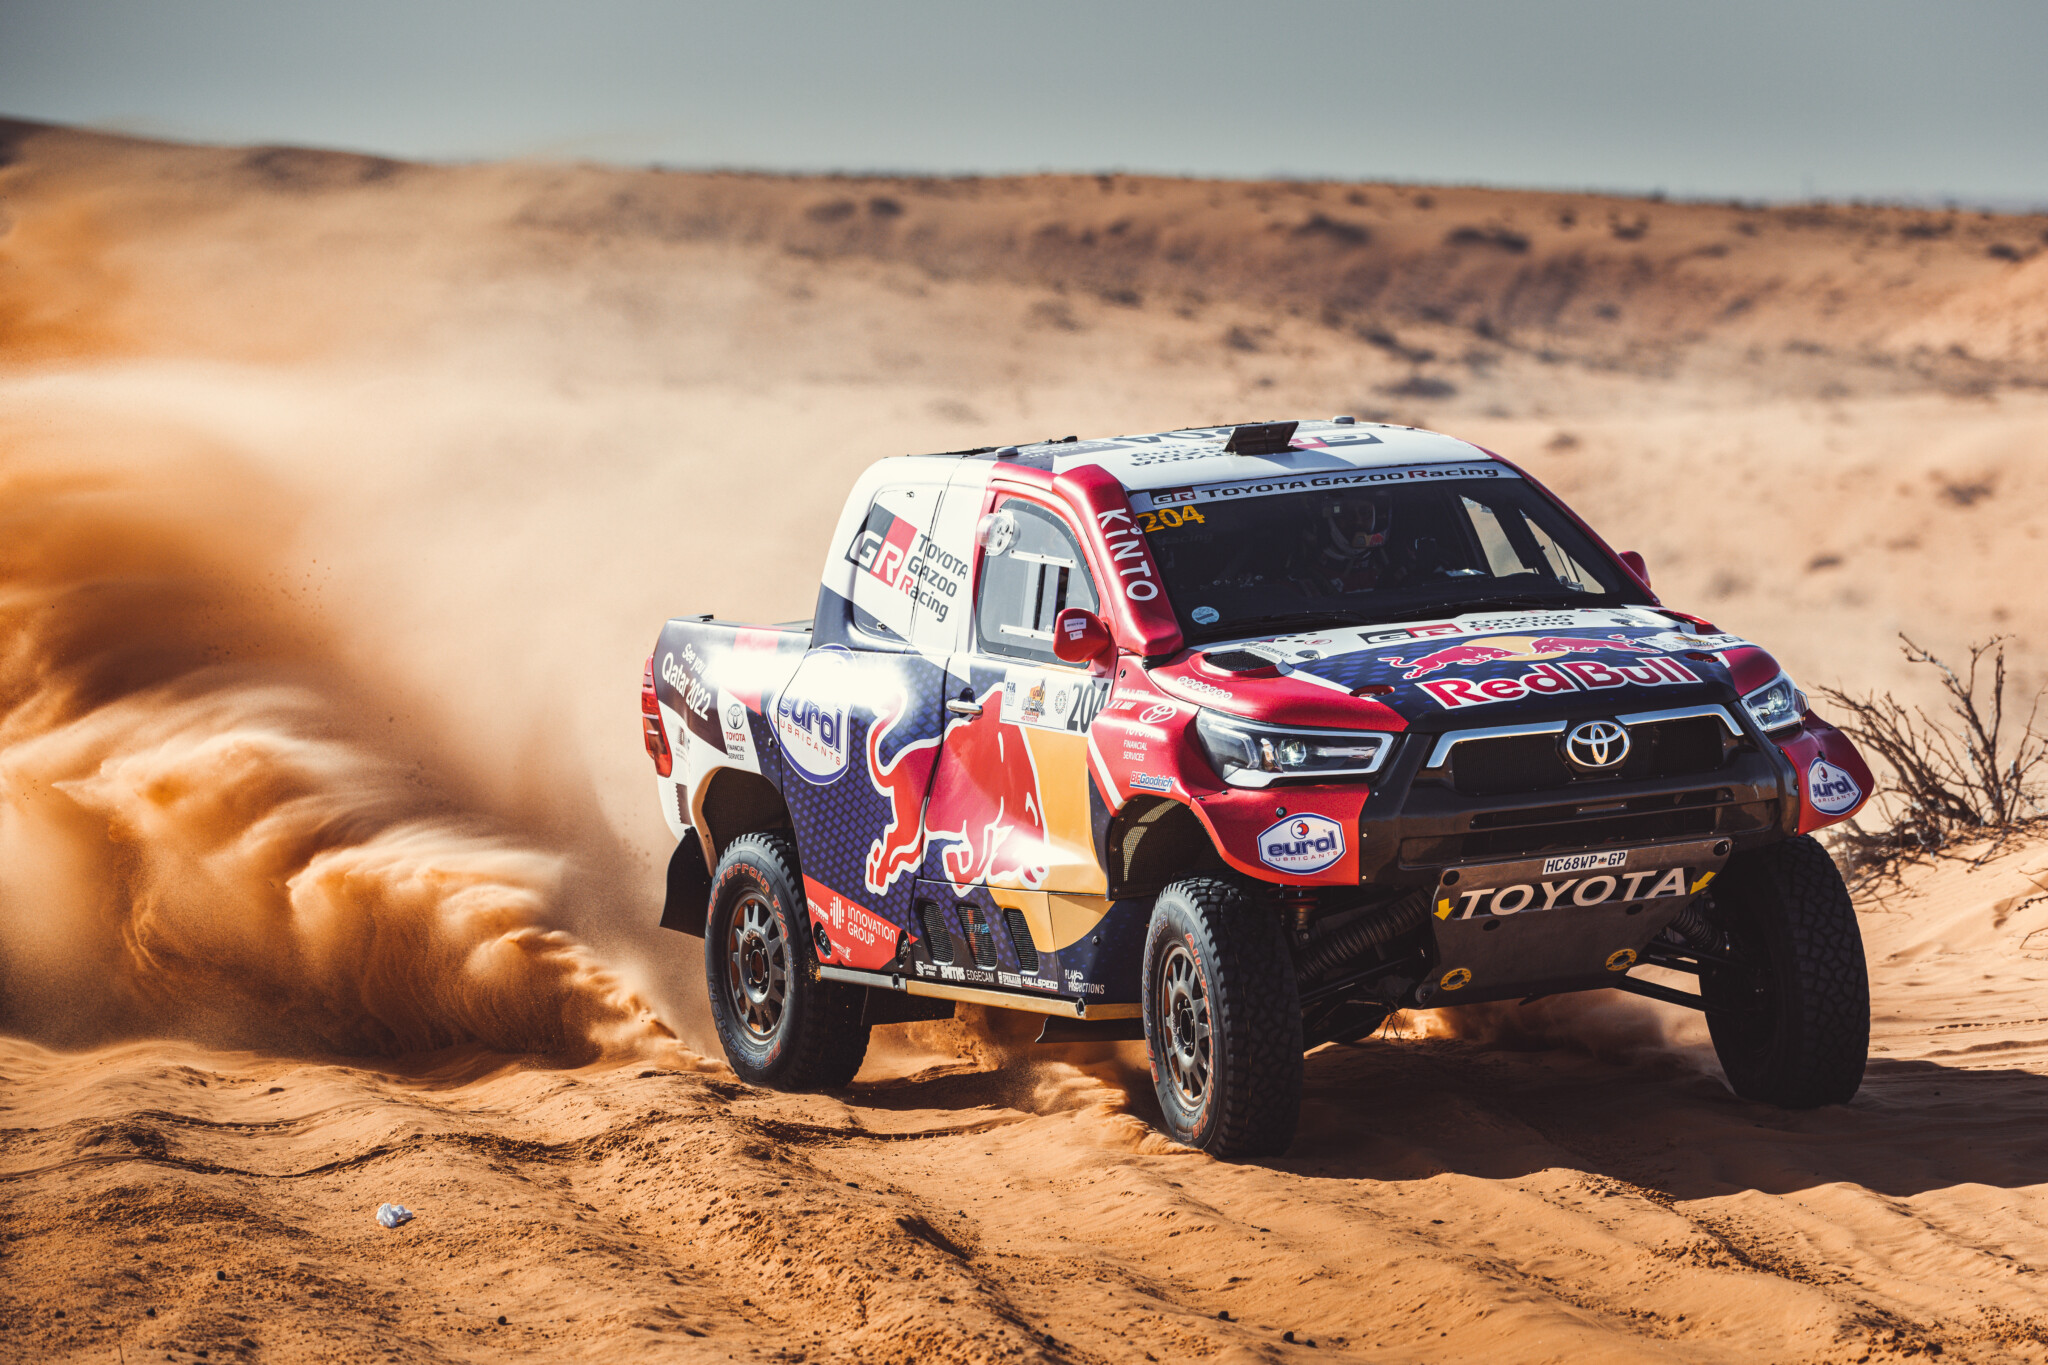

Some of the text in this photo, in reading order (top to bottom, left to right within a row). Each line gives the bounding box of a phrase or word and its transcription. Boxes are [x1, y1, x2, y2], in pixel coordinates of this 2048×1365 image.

[1153, 467, 1499, 505] GR TOYOTA GAZOO Racing
[1136, 505, 1205, 532] 204
[848, 529, 905, 585] GR
[918, 533, 968, 580] TOYOTA
[907, 556, 957, 598] GAZOO
[898, 574, 949, 623] Racing
[682, 643, 696, 666] See
[662, 652, 690, 699] Qatar
[685, 677, 712, 721] 2022
[1417, 657, 1701, 709] Red Bull
[1066, 679, 1109, 734] 204
[725, 731, 746, 743] TOYOTA
[726, 743, 745, 753] FINANCIAL
[773, 715, 841, 766] LUBRICANTS
[1123, 739, 1148, 751] FINANCIAL
[727, 752, 745, 761] SERVICES
[1122, 751, 1145, 761] SERVICES
[1130, 772, 1173, 788] BFGoodrich
[1267, 829, 1337, 857] eurol
[1268, 850, 1338, 862] LUBRICANTS
[1544, 852, 1626, 873] HC68WP GP
[1459, 867, 1686, 920] TOYOTA
[847, 922, 875, 947] GROUP
[966, 969, 995, 983] EDGECAM
[1021, 976, 1059, 990] HALLSPEED
